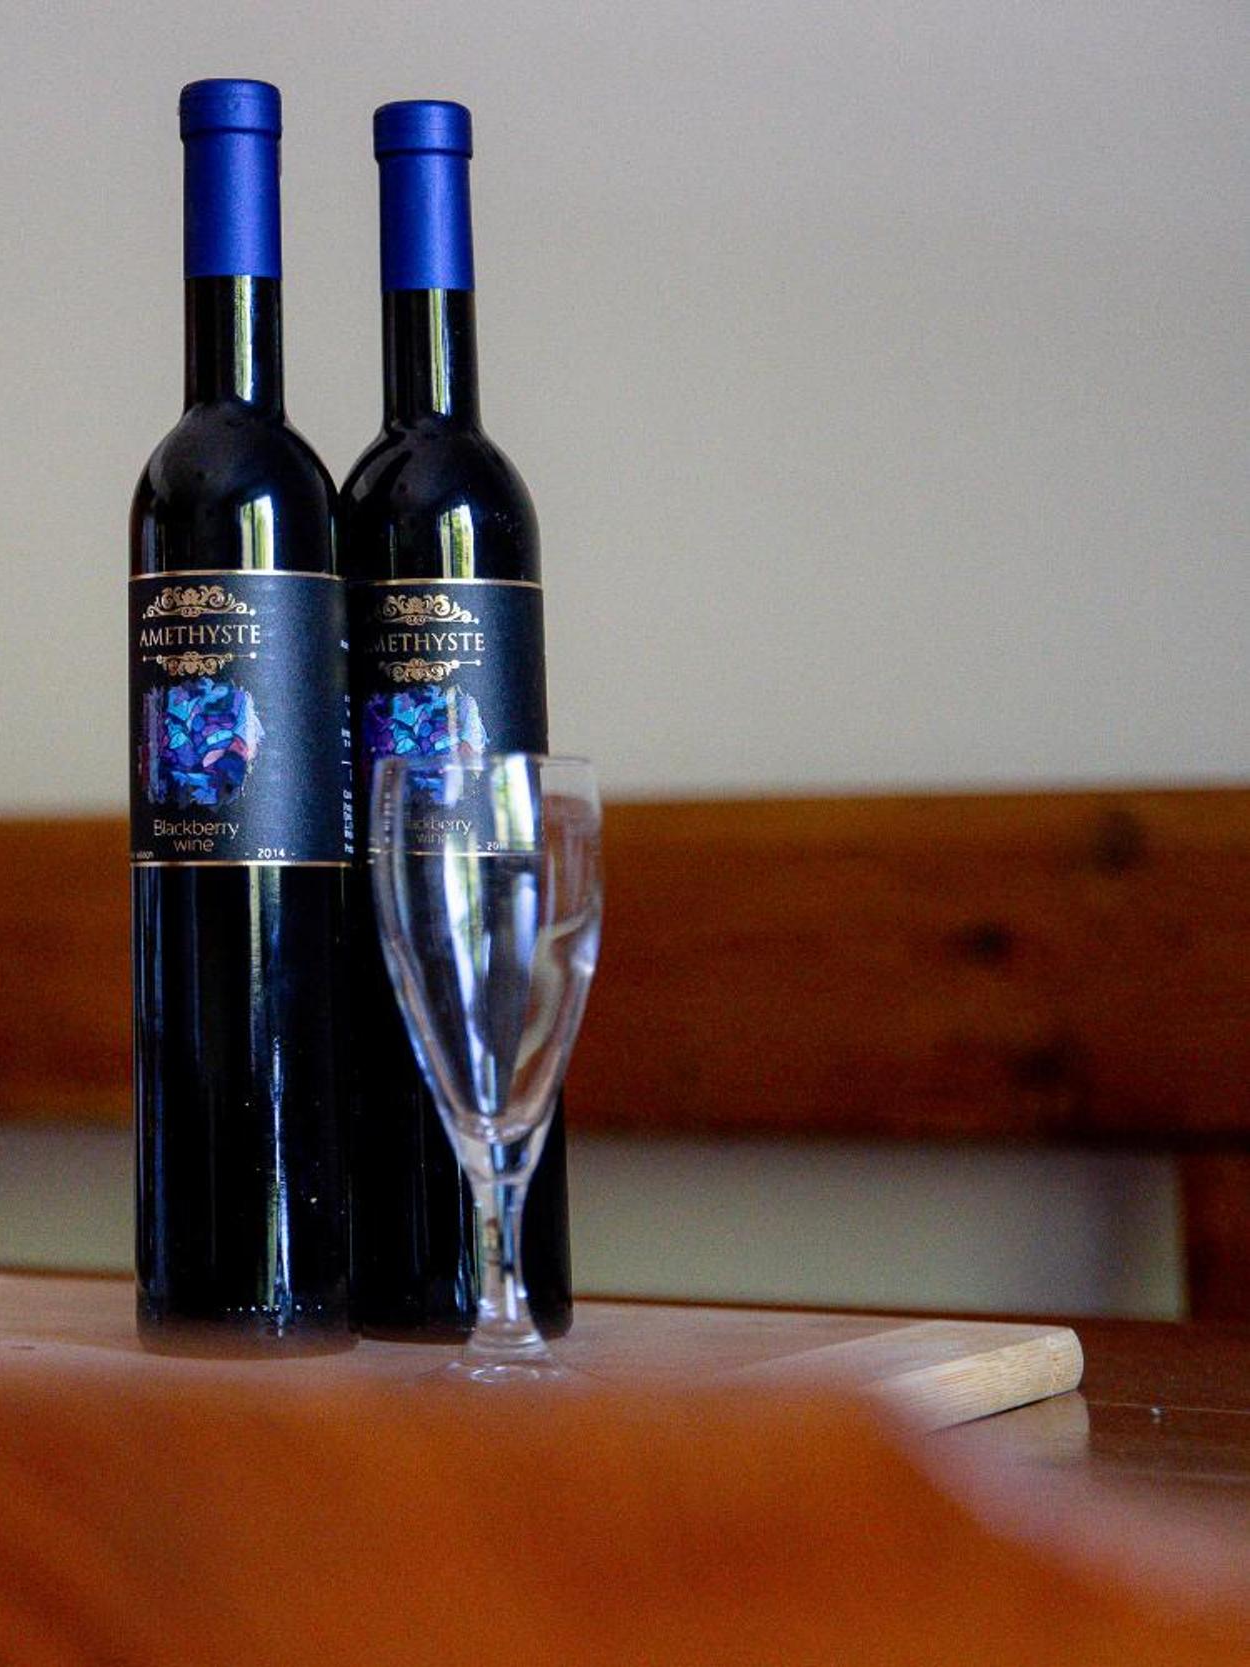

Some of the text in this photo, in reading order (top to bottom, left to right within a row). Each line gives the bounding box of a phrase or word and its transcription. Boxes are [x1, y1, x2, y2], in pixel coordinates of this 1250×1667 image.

[139, 623, 261, 647] AMETHYSTE
[365, 631, 486, 654] METHYSTE
[153, 819, 240, 840] Blackberry
[173, 837, 215, 853] wine
[257, 848, 286, 859] 2014
